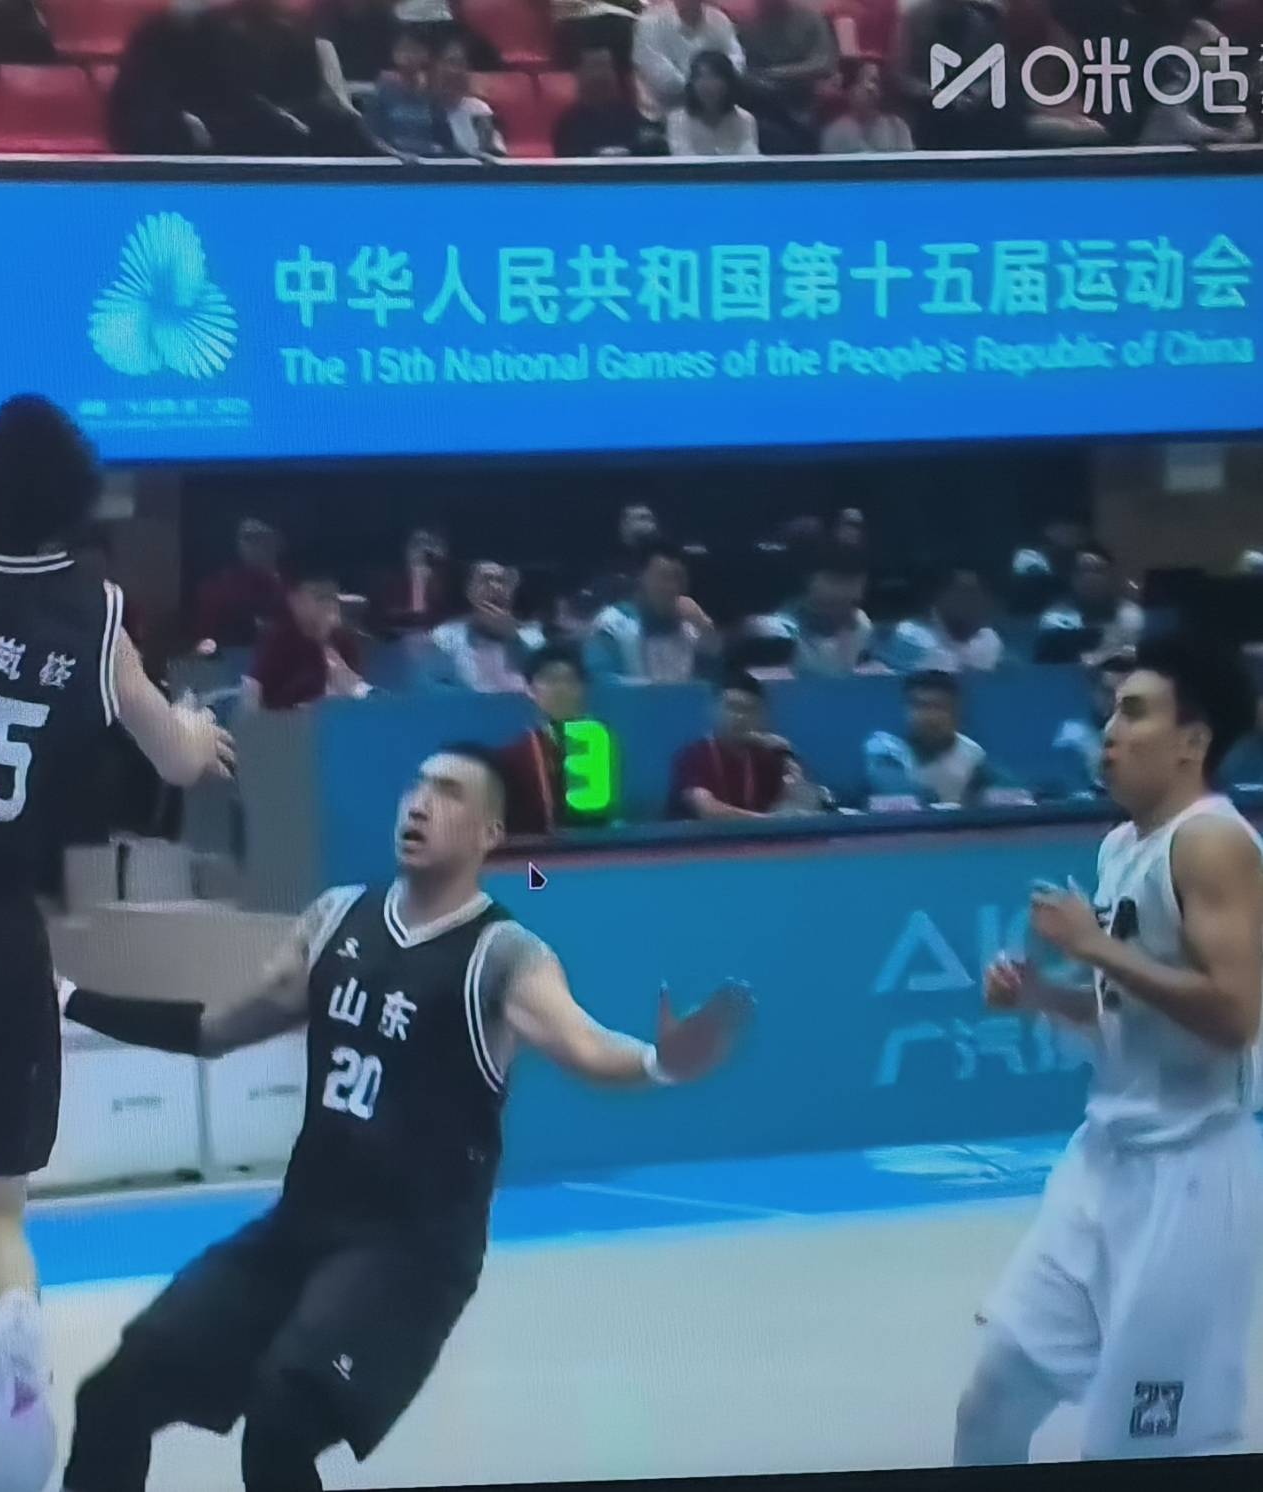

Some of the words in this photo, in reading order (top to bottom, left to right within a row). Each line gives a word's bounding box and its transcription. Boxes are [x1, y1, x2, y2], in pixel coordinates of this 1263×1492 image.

[274, 234, 1252, 328] 中华人民共和国第十五届运动会
[281, 347, 347, 387] The
[357, 346, 436, 384] 15th
[444, 343, 588, 383] National
[596, 344, 716, 381] Games
[722, 339, 758, 379] of
[766, 340, 822, 375] the
[828, 337, 967, 381] People's
[974, 334, 1114, 376] Republic
[1121, 331, 1157, 367] of
[1163, 329, 1254, 365] China
[328, 977, 418, 1041] 山东
[322, 1046, 383, 1120] 20
